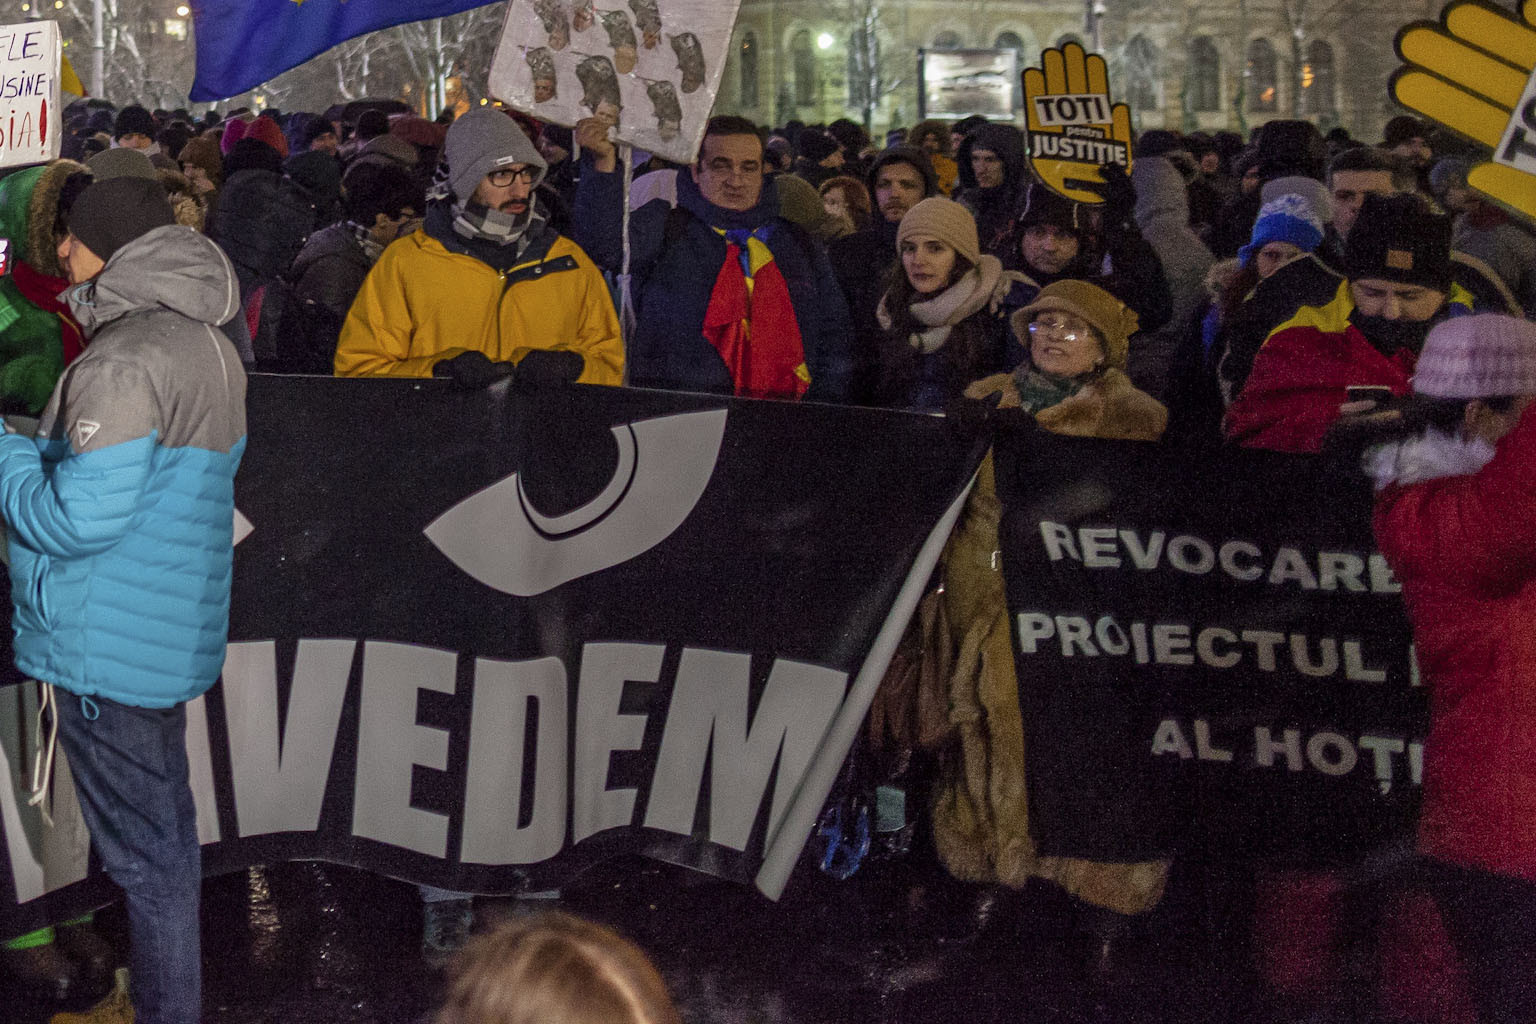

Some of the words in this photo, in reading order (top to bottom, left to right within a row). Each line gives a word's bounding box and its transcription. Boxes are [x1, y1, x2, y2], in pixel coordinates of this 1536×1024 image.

[1036, 97, 1105, 124] TOȚI
[1017, 611, 1387, 683] PROIECTUL
[1151, 719, 1233, 763] AL
